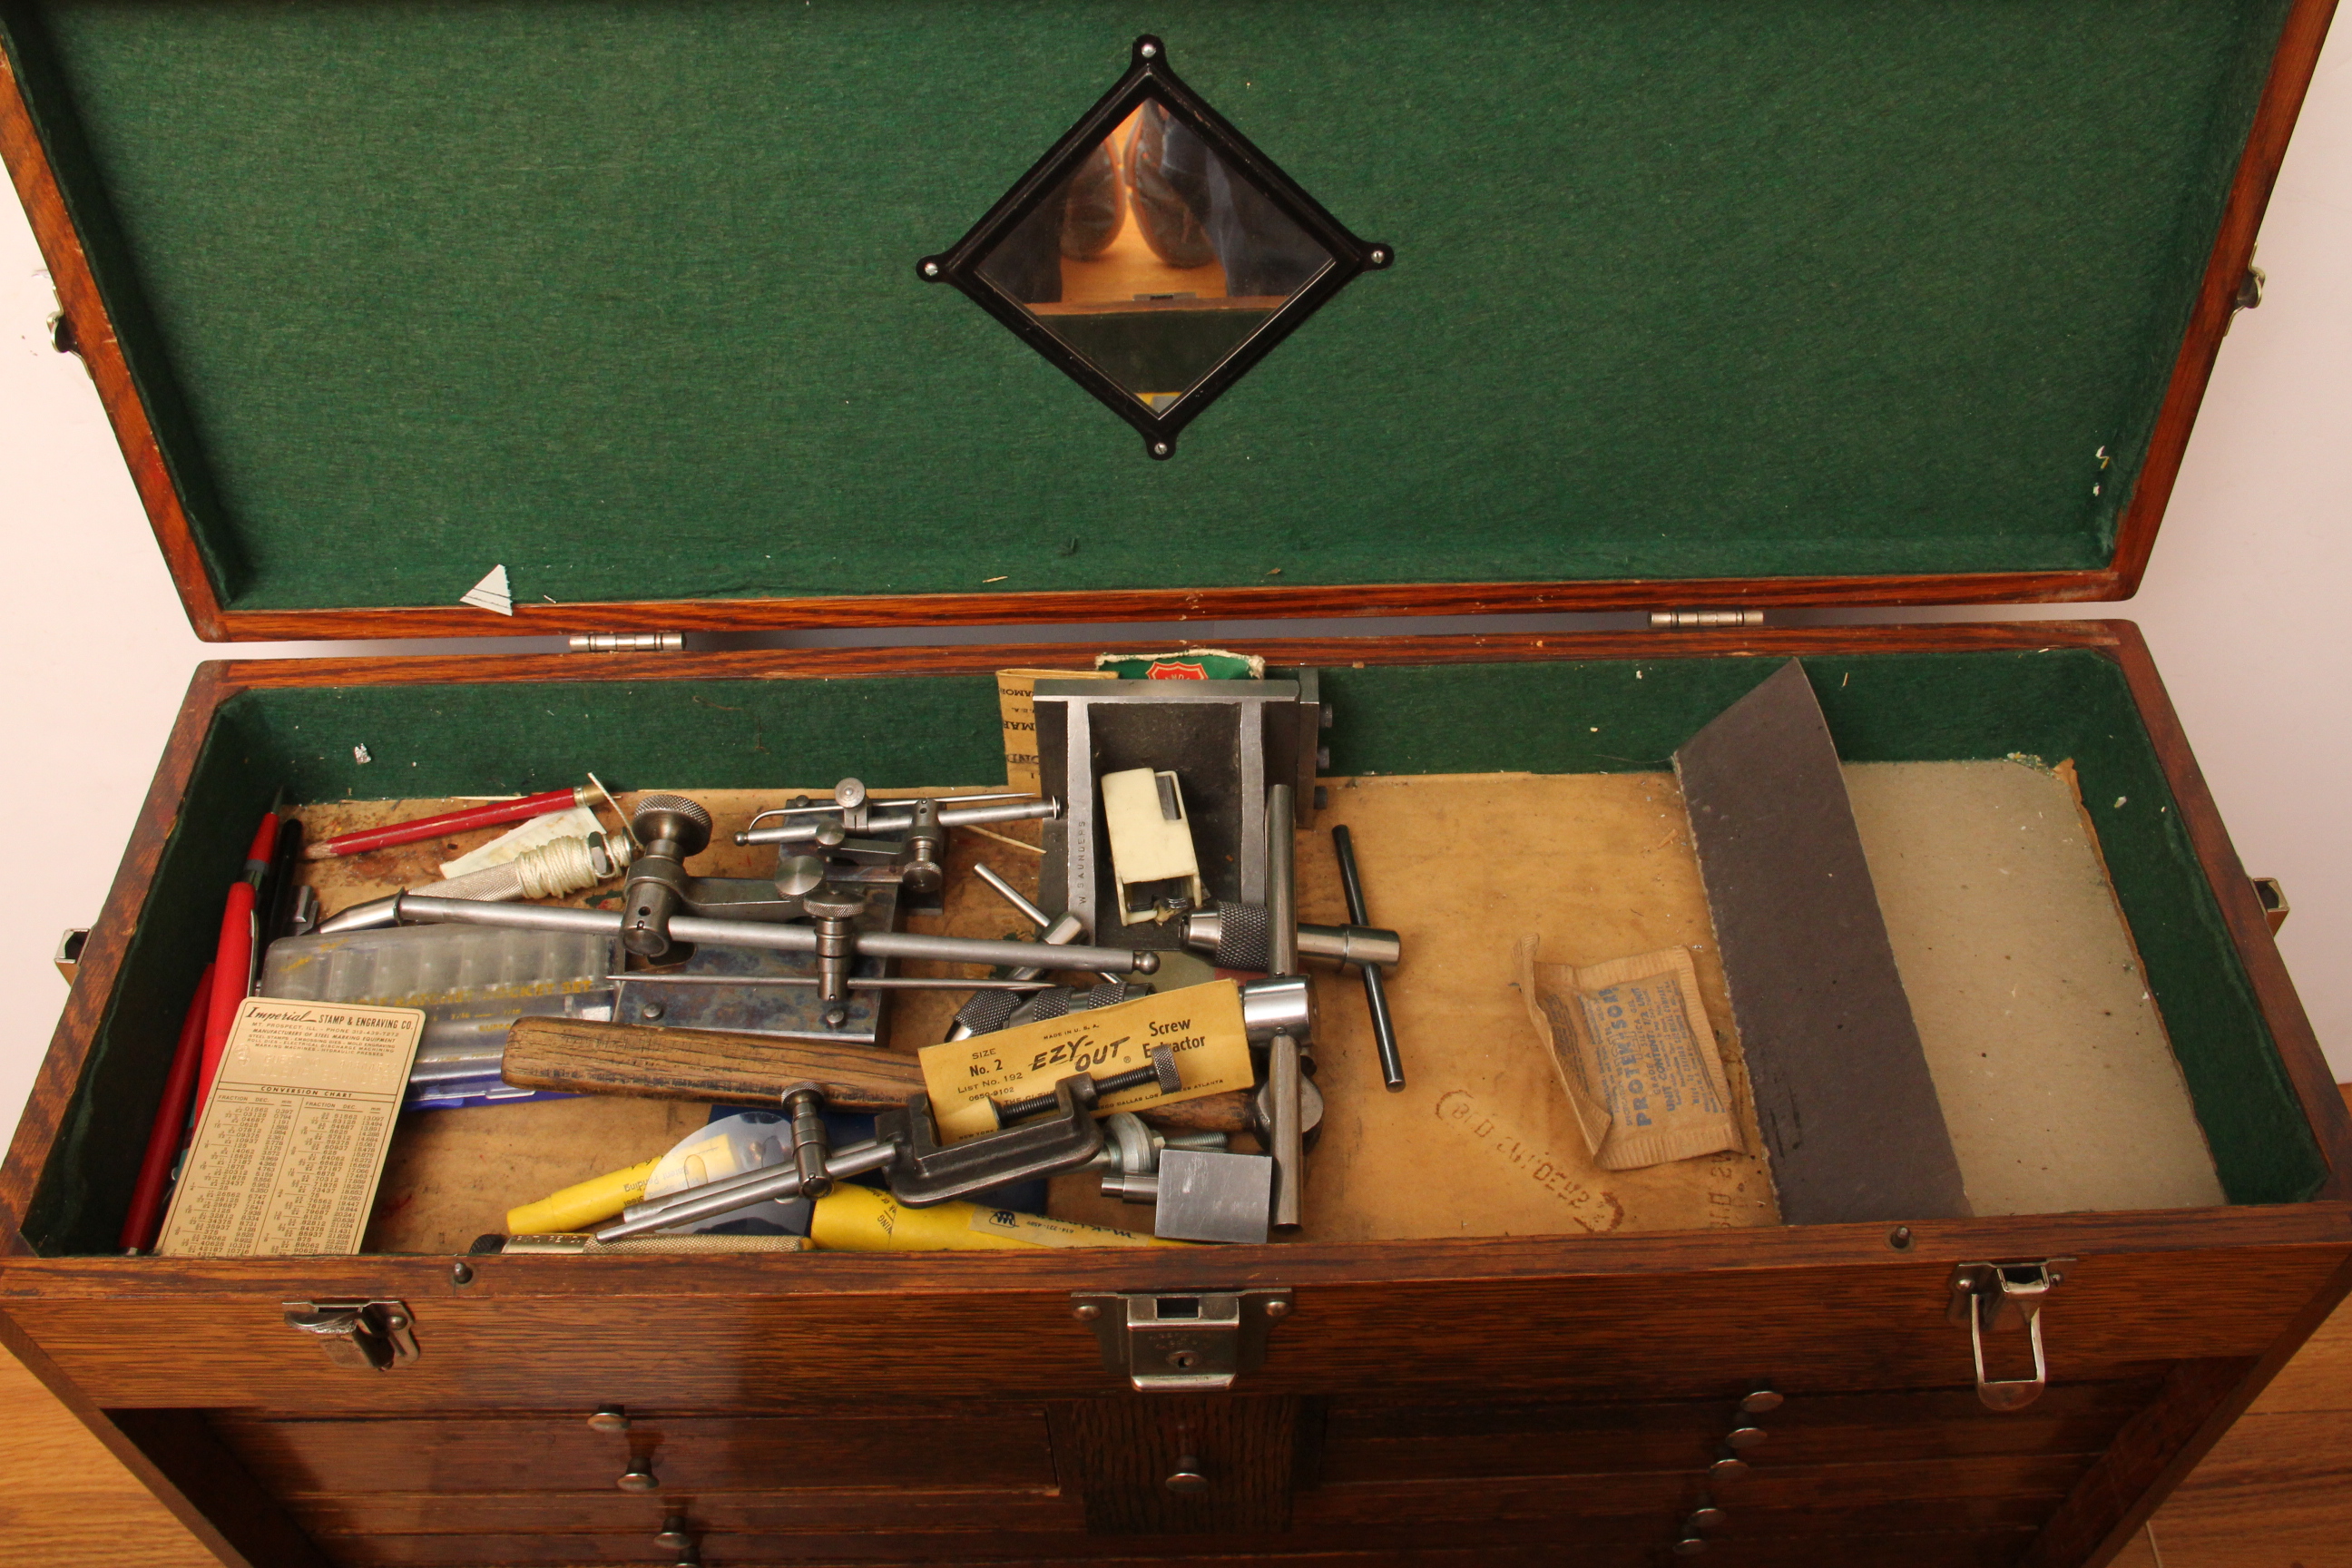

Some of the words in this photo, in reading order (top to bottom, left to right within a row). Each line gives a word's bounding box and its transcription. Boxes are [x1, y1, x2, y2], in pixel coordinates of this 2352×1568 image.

[1078, 894, 1086, 904] W
[561, 980, 593, 995] SET
[245, 1006, 317, 1024] Imperial
[319, 1014, 344, 1024] STAMP
[347, 1016, 353, 1024] &
[355, 1016, 399, 1028] ENGRAVING
[400, 1020, 415, 1030] CO.
[1149, 1018, 1191, 1036] Screw
[1044, 1032, 1063, 1040] MADE
[1634, 1018, 1648, 1047] SILICA
[972, 1048, 996, 1060] SIZE
[1074, 1035, 1131, 1073] OUT
[1142, 1036, 1206, 1059] Eactor
[969, 1064, 990, 1077] No.
[994, 1059, 1004, 1072] 2
[1004, 1073, 1024, 1083] 192
[1193, 1079, 1224, 1090] ATLANTA
[1647, 1063, 1661, 1095] GRADE
[260, 1086, 318, 1094] CONVERSION
[1662, 1085, 1676, 1112] UNIT
[1117, 1096, 1143, 1106] DALLAS
[623, 1175, 660, 1193] Pending
